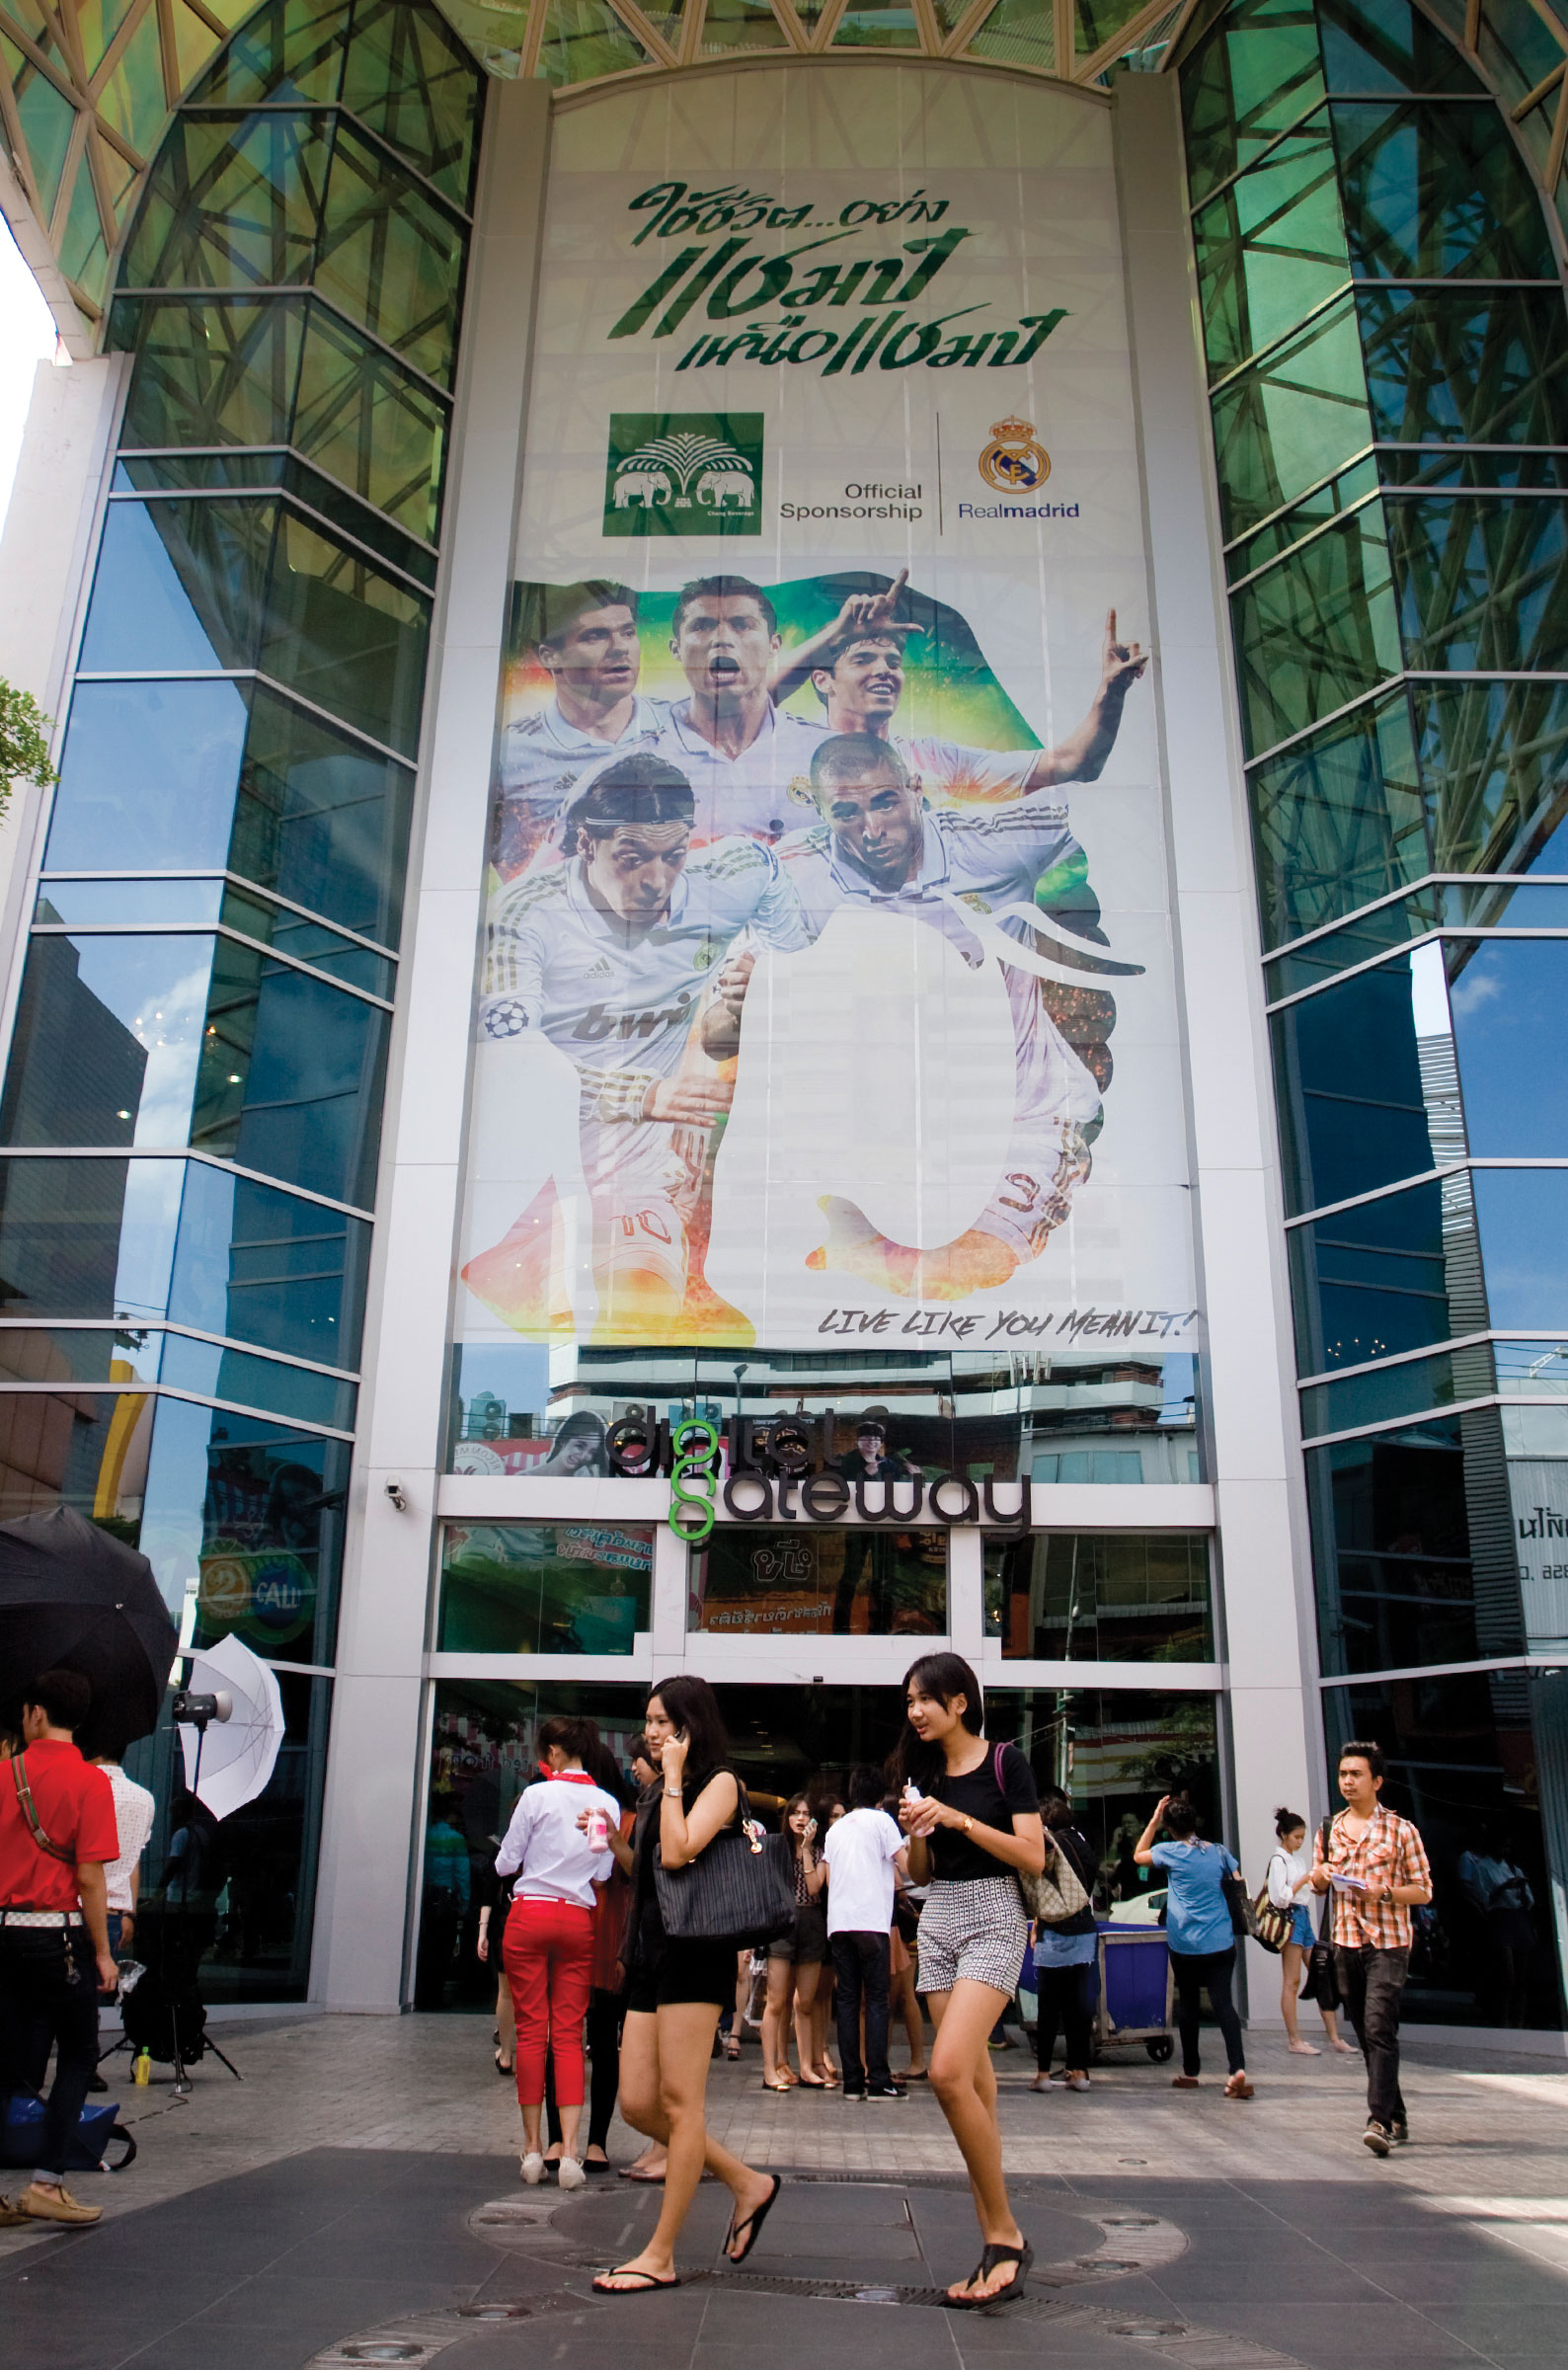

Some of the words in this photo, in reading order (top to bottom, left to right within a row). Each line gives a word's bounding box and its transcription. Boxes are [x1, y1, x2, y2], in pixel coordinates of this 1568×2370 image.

[844, 483, 922, 500] Official
[779, 503, 922, 522] Sponsorship
[959, 503, 1080, 519] Realmadrid
[583, 969, 616, 981] adidas
[818, 1308, 900, 1334] LIVE
[902, 1310, 985, 1341] LIKE
[984, 1309, 1054, 1341] YOU
[1057, 1306, 1143, 1344] MEAN
[605, 1406, 843, 1483] digital
[668, 1468, 1032, 1541] gateway
